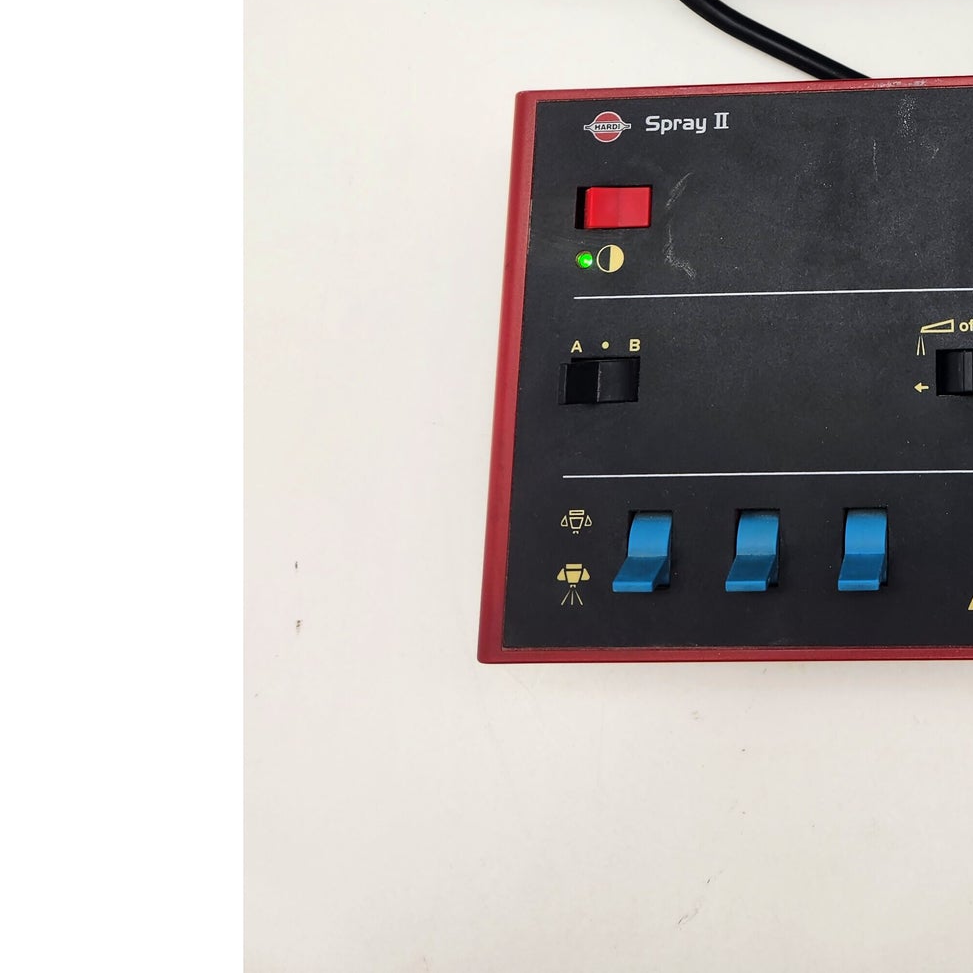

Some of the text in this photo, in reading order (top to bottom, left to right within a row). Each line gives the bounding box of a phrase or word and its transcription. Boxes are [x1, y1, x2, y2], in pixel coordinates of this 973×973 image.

[594, 123, 621, 131] HARDI
[645, 112, 730, 136] Spray II
[570, 339, 641, 354] A B
